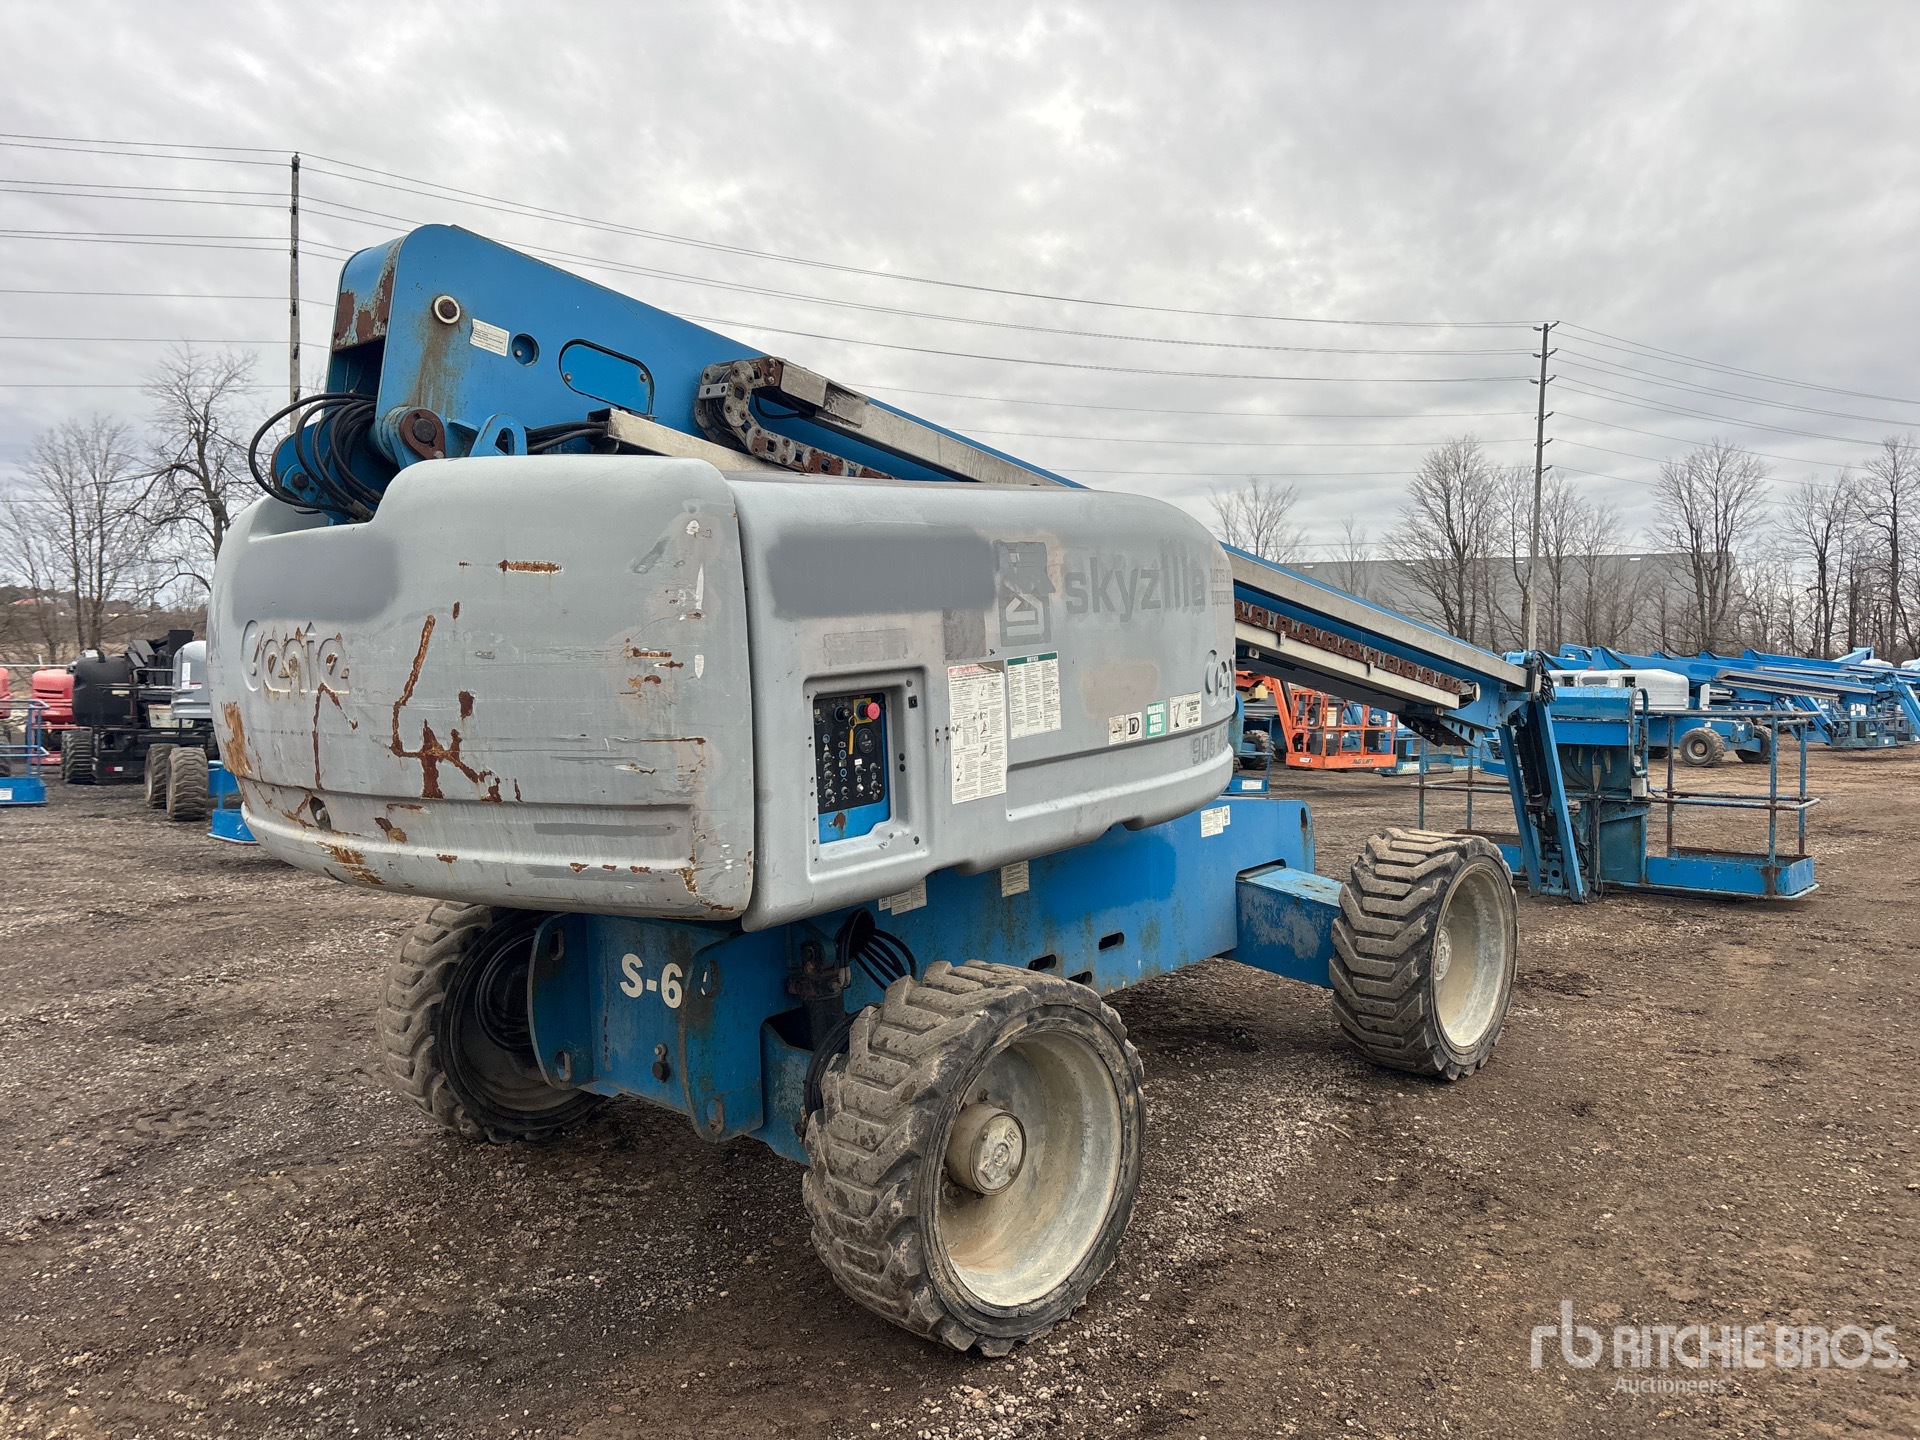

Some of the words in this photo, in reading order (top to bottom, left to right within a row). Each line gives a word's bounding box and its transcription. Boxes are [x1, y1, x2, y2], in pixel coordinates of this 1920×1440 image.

[241, 619, 350, 693] Genie
[1147, 703, 1164, 715] DIESEL
[1150, 713, 1162, 724] FUEL
[620, 953, 707, 1009] S-6
